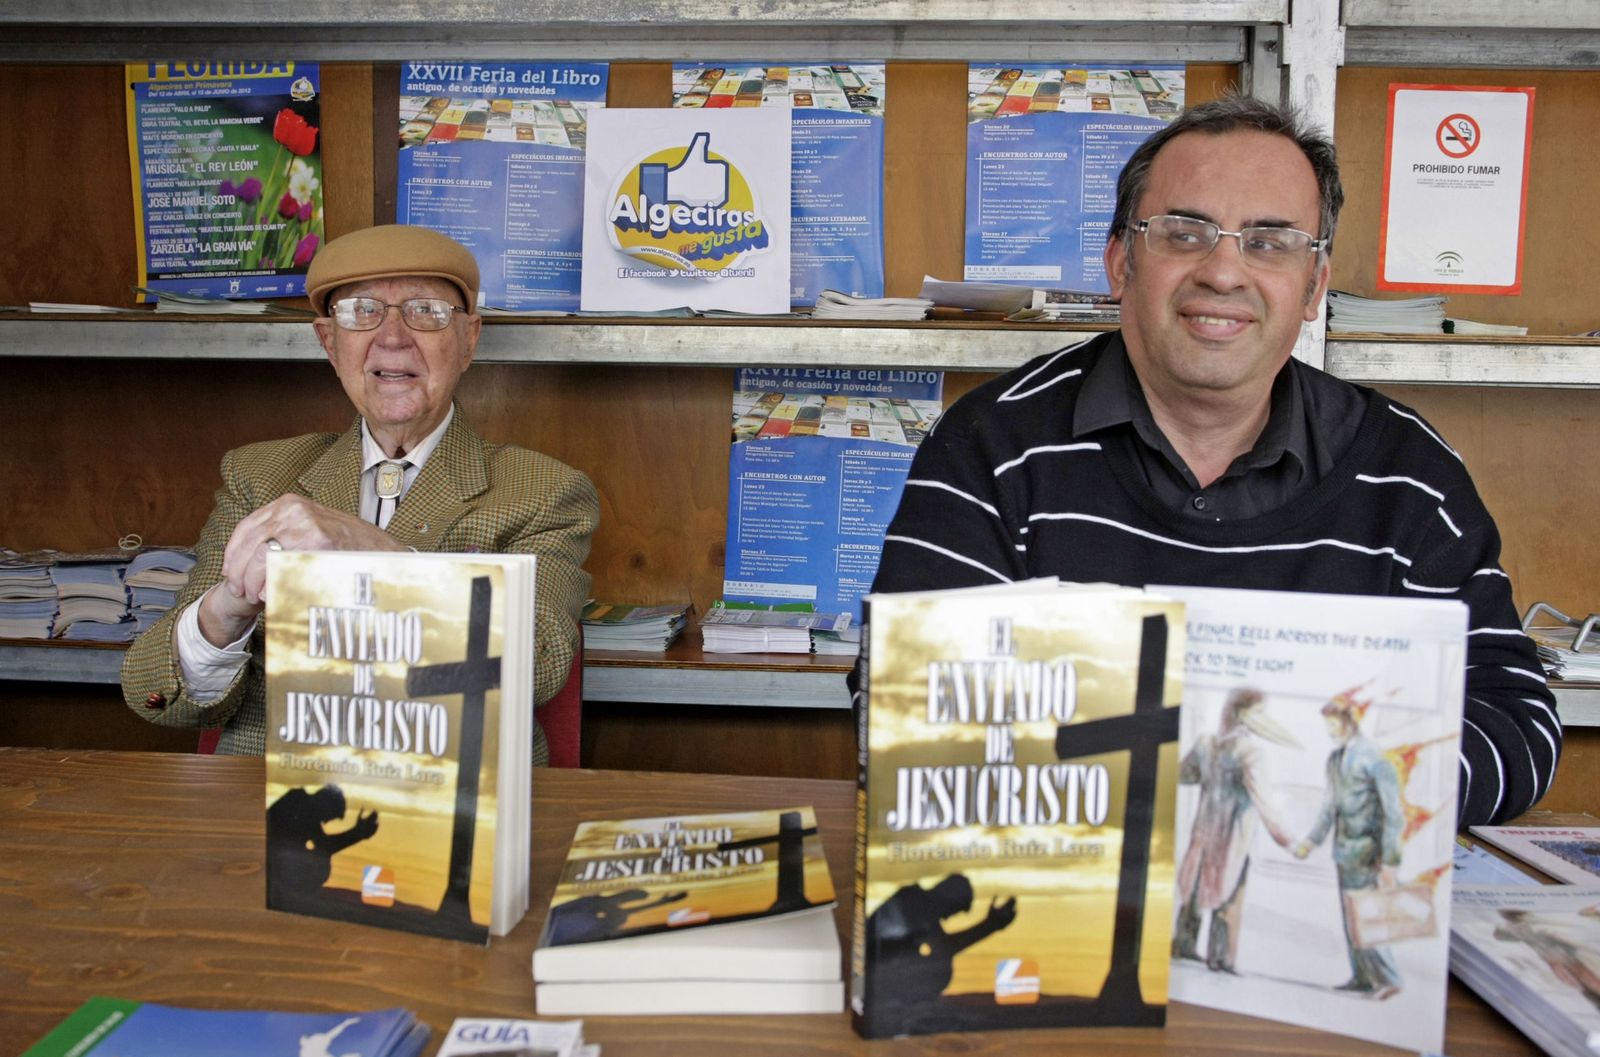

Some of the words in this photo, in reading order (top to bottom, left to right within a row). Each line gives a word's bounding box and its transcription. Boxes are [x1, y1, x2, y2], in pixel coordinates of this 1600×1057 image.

[406, 82, 446, 93] antiguo,
[449, 82, 461, 92] de
[462, 83, 498, 94] ocasión
[499, 86, 506, 96] y
[507, 85, 556, 95] novedades
[408, 64, 464, 81] XXVII
[470, 66, 516, 83] Feria
[522, 70, 546, 84] del
[551, 69, 600, 86] Libro
[146, 164, 188, 174] MUSICAL
[190, 162, 208, 172] "EL
[208, 162, 228, 172] REY
[229, 160, 259, 171] LEÓN"
[1412, 164, 1464, 174] PROHIBIDO
[1467, 165, 1500, 175] FUMAR
[172, 196, 209, 207] MANUEL
[212, 194, 236, 206] SOTO
[609, 194, 754, 232] Algeciras
[151, 244, 194, 254] ZARZUELA
[195, 242, 212, 253] "LA
[212, 241, 237, 252] GRAN
[238, 238, 256, 251] VÍA"
[678, 241, 698, 255] me
[701, 218, 763, 254] gusta
[629, 268, 666, 278] facebook
[680, 268, 720, 278] twitter
[740, 378, 780, 388] antiguo,
[782, 378, 794, 388] de
[796, 378, 832, 390] ocasión
[834, 383, 840, 392] y
[842, 383, 893, 393] novedades
[804, 368, 852, 380] Feria
[858, 370, 881, 381] del
[888, 370, 938, 384] Libro
[744, 472, 788, 480] ENCUENTROS
[354, 573, 375, 607] EL
[308, 607, 424, 666] ENVIADO
[988, 616, 1018, 656] EL
[1196, 622, 1234, 638] FINAL
[1240, 625, 1270, 641] BELL
[1275, 629, 1328, 646] ACROSS
[1333, 634, 1357, 648] THE
[1364, 636, 1410, 652] DEATH
[1207, 653, 1222, 666] TO
[1227, 654, 1250, 670] THE
[1256, 658, 1296, 673] LIGHT
[352, 663, 376, 697] DE
[926, 660, 1077, 725] ENVIADO
[279, 692, 449, 757] JESUCRISTO
[984, 724, 1014, 764] DE
[279, 752, 360, 777] Florencio
[364, 762, 402, 780] Ruiz
[406, 764, 446, 785] Lara
[885, 764, 1110, 831] JESUCRISTO
[614, 827, 733, 851] ENVIADO
[886, 840, 992, 865] Florencio
[1000, 837, 1048, 858] Ruiz
[1054, 835, 1105, 858] Lara
[575, 847, 765, 880] JESUCRISTO
[458, 1020, 529, 1044] GUÍA
